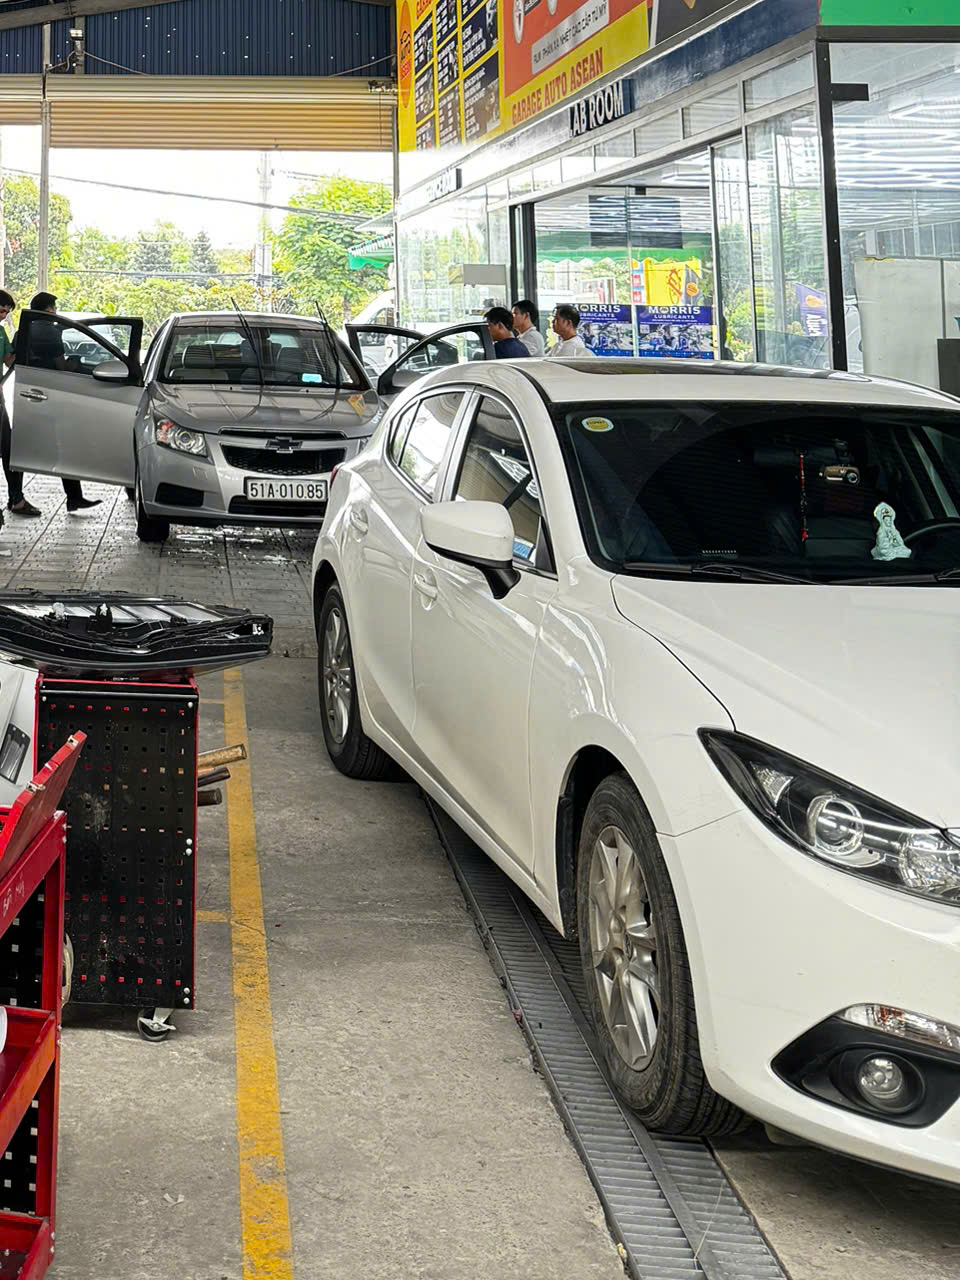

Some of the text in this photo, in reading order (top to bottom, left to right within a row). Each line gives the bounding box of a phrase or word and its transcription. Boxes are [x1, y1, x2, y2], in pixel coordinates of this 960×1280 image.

[511, 87, 542, 126] GARAGE
[543, 71, 568, 108] AUTO
[569, 46, 604, 93] ASEAN
[589, 79, 624, 130] ROOM
[648, 306, 701, 315] MORRIS
